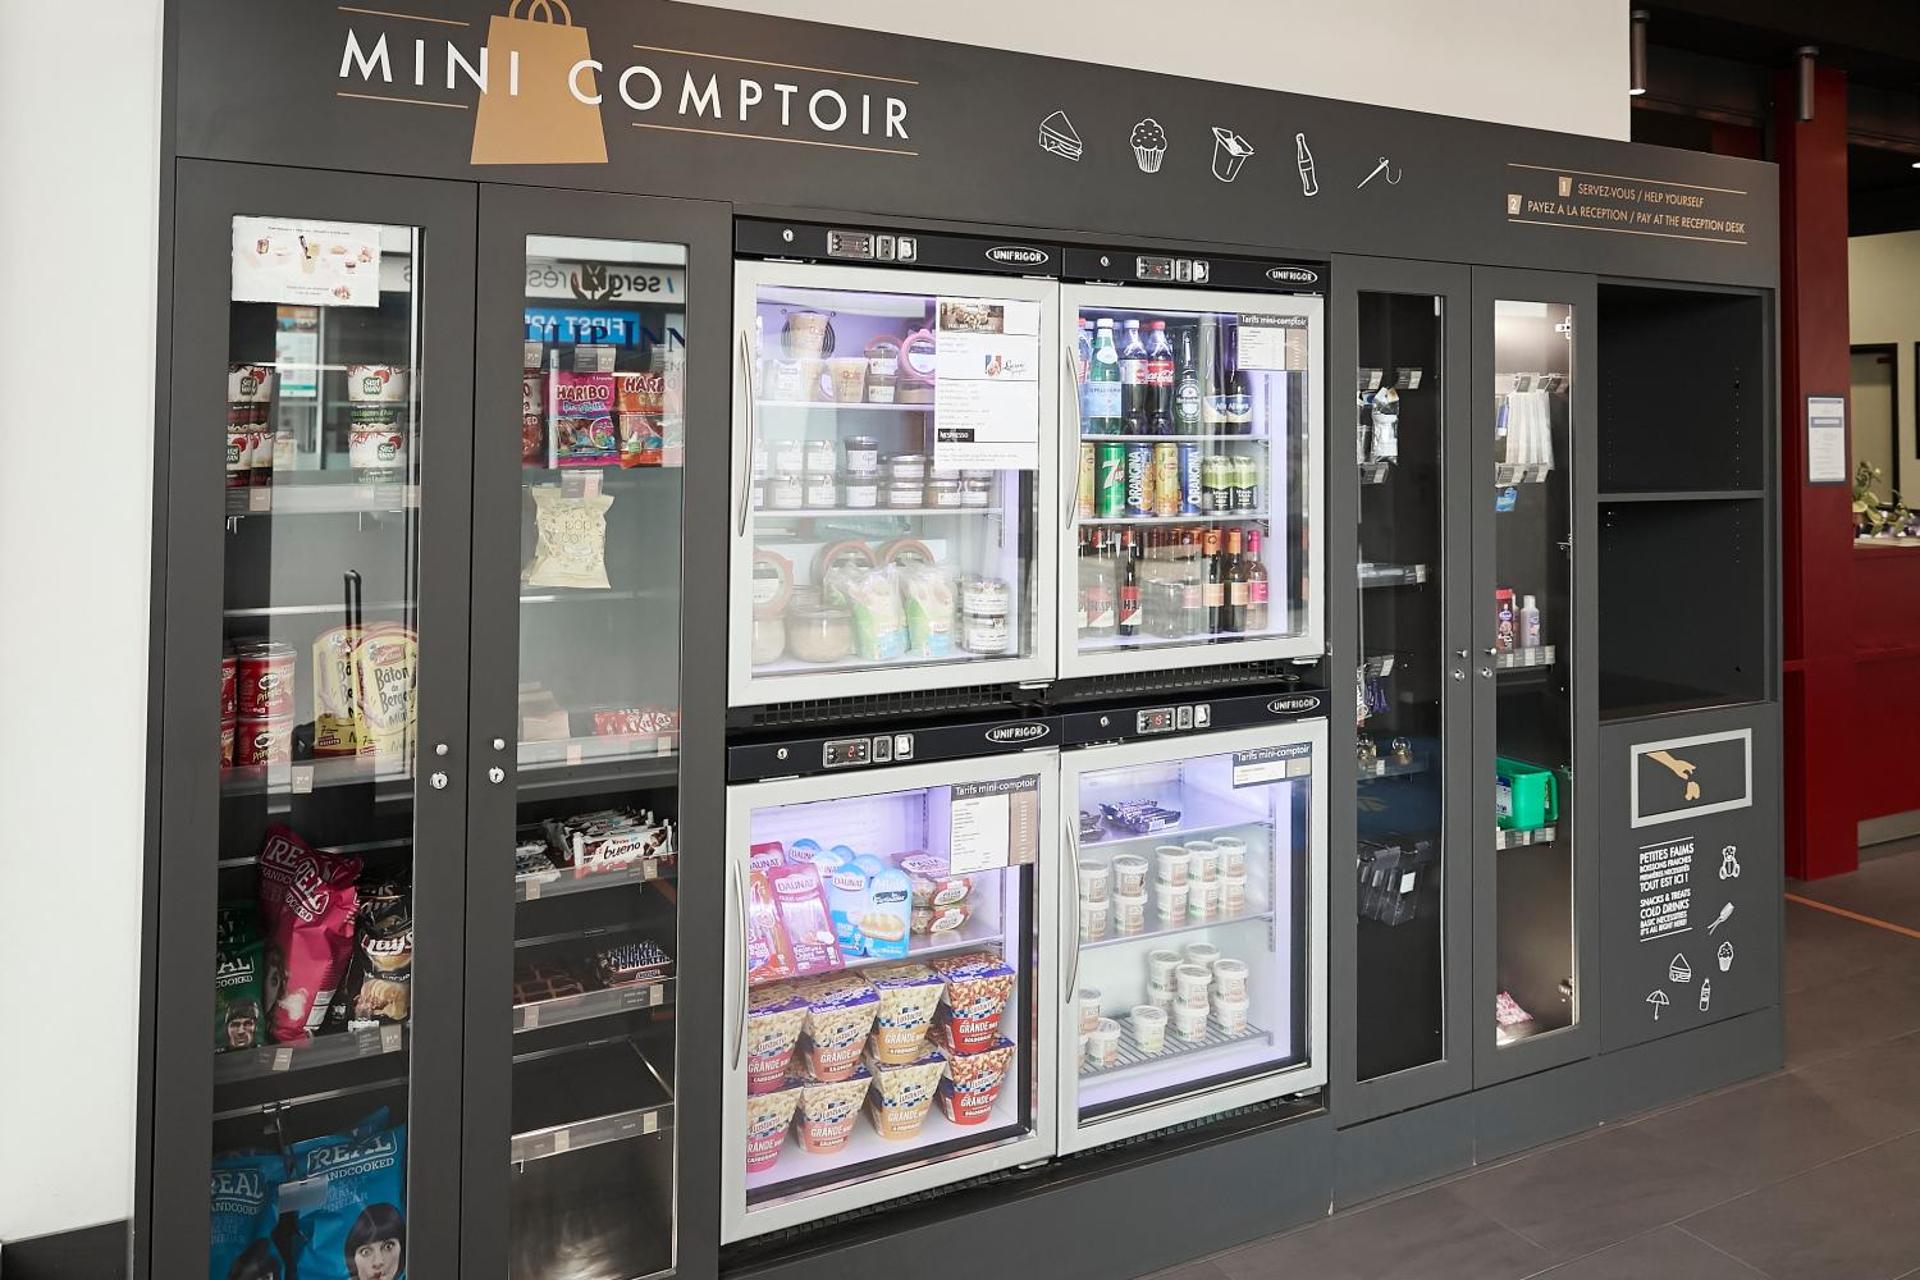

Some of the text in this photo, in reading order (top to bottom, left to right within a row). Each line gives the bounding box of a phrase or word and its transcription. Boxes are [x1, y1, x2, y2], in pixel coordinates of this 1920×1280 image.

[338, 27, 910, 140] MINI COMPTOIR
[1578, 183, 1636, 201] SERVEZ-VOUS
[1644, 193, 1663, 203] HELP
[1664, 194, 1705, 208] YOURSELF
[1527, 201, 1555, 214] PAYEZ
[1567, 206, 1578, 216] LA
[1580, 206, 1628, 221] RECEPTION
[1636, 212, 1652, 223] PAY
[1653, 214, 1663, 224] AT
[1665, 215, 1679, 226] THE
[1681, 216, 1724, 231] RECEPTION
[1725, 222, 1746, 233] DESK
[993, 249, 1042, 263] UNIFRIGOR
[1241, 314, 1307, 327] Tarifs mini-comptoir
[556, 384, 609, 401] HARIBO
[992, 726, 1044, 741] UNIFRIGOR
[1238, 744, 1311, 762] Tarifs mini-comptoir
[956, 778, 1036, 796] Tarifs mini-comptoir
[603, 840, 641, 860] bueno
[1639, 843, 1694, 865] PETITES FAIMS
[1640, 879, 1660, 893] TOUT
[1660, 876, 1673, 888] EST
[1673, 873, 1684, 885] ICI
[1640, 894, 1665, 908] SNACKS
[1671, 888, 1691, 901] TREATS
[1640, 899, 1690, 919] COLD DRINKS
[960, 1022, 989, 1035] GRANDE
[748, 1059, 780, 1073] GRANDE
[820, 1050, 851, 1064] GRANDE
[748, 1141, 773, 1153] RANDE
